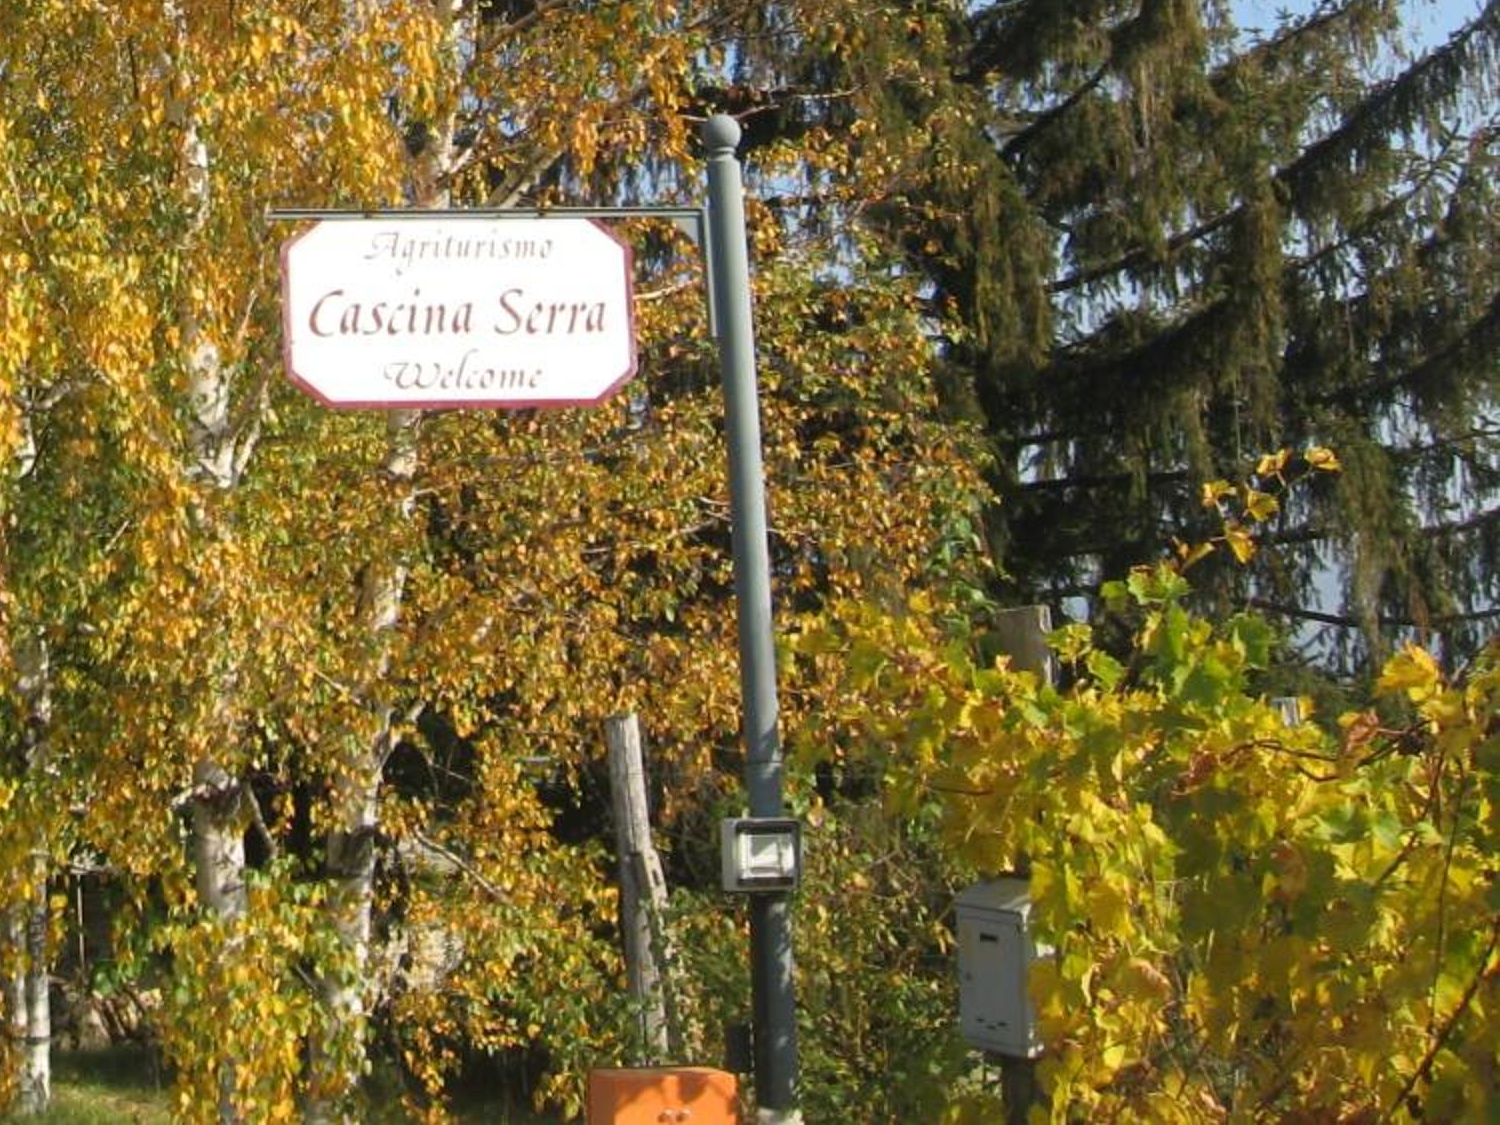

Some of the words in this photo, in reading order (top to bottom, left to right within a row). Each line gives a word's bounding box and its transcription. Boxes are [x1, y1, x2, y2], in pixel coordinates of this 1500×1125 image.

[365, 230, 553, 276] Agriturismo
[309, 288, 474, 338] Cascina
[494, 287, 606, 335] Serra
[384, 348, 543, 390] Welcome
